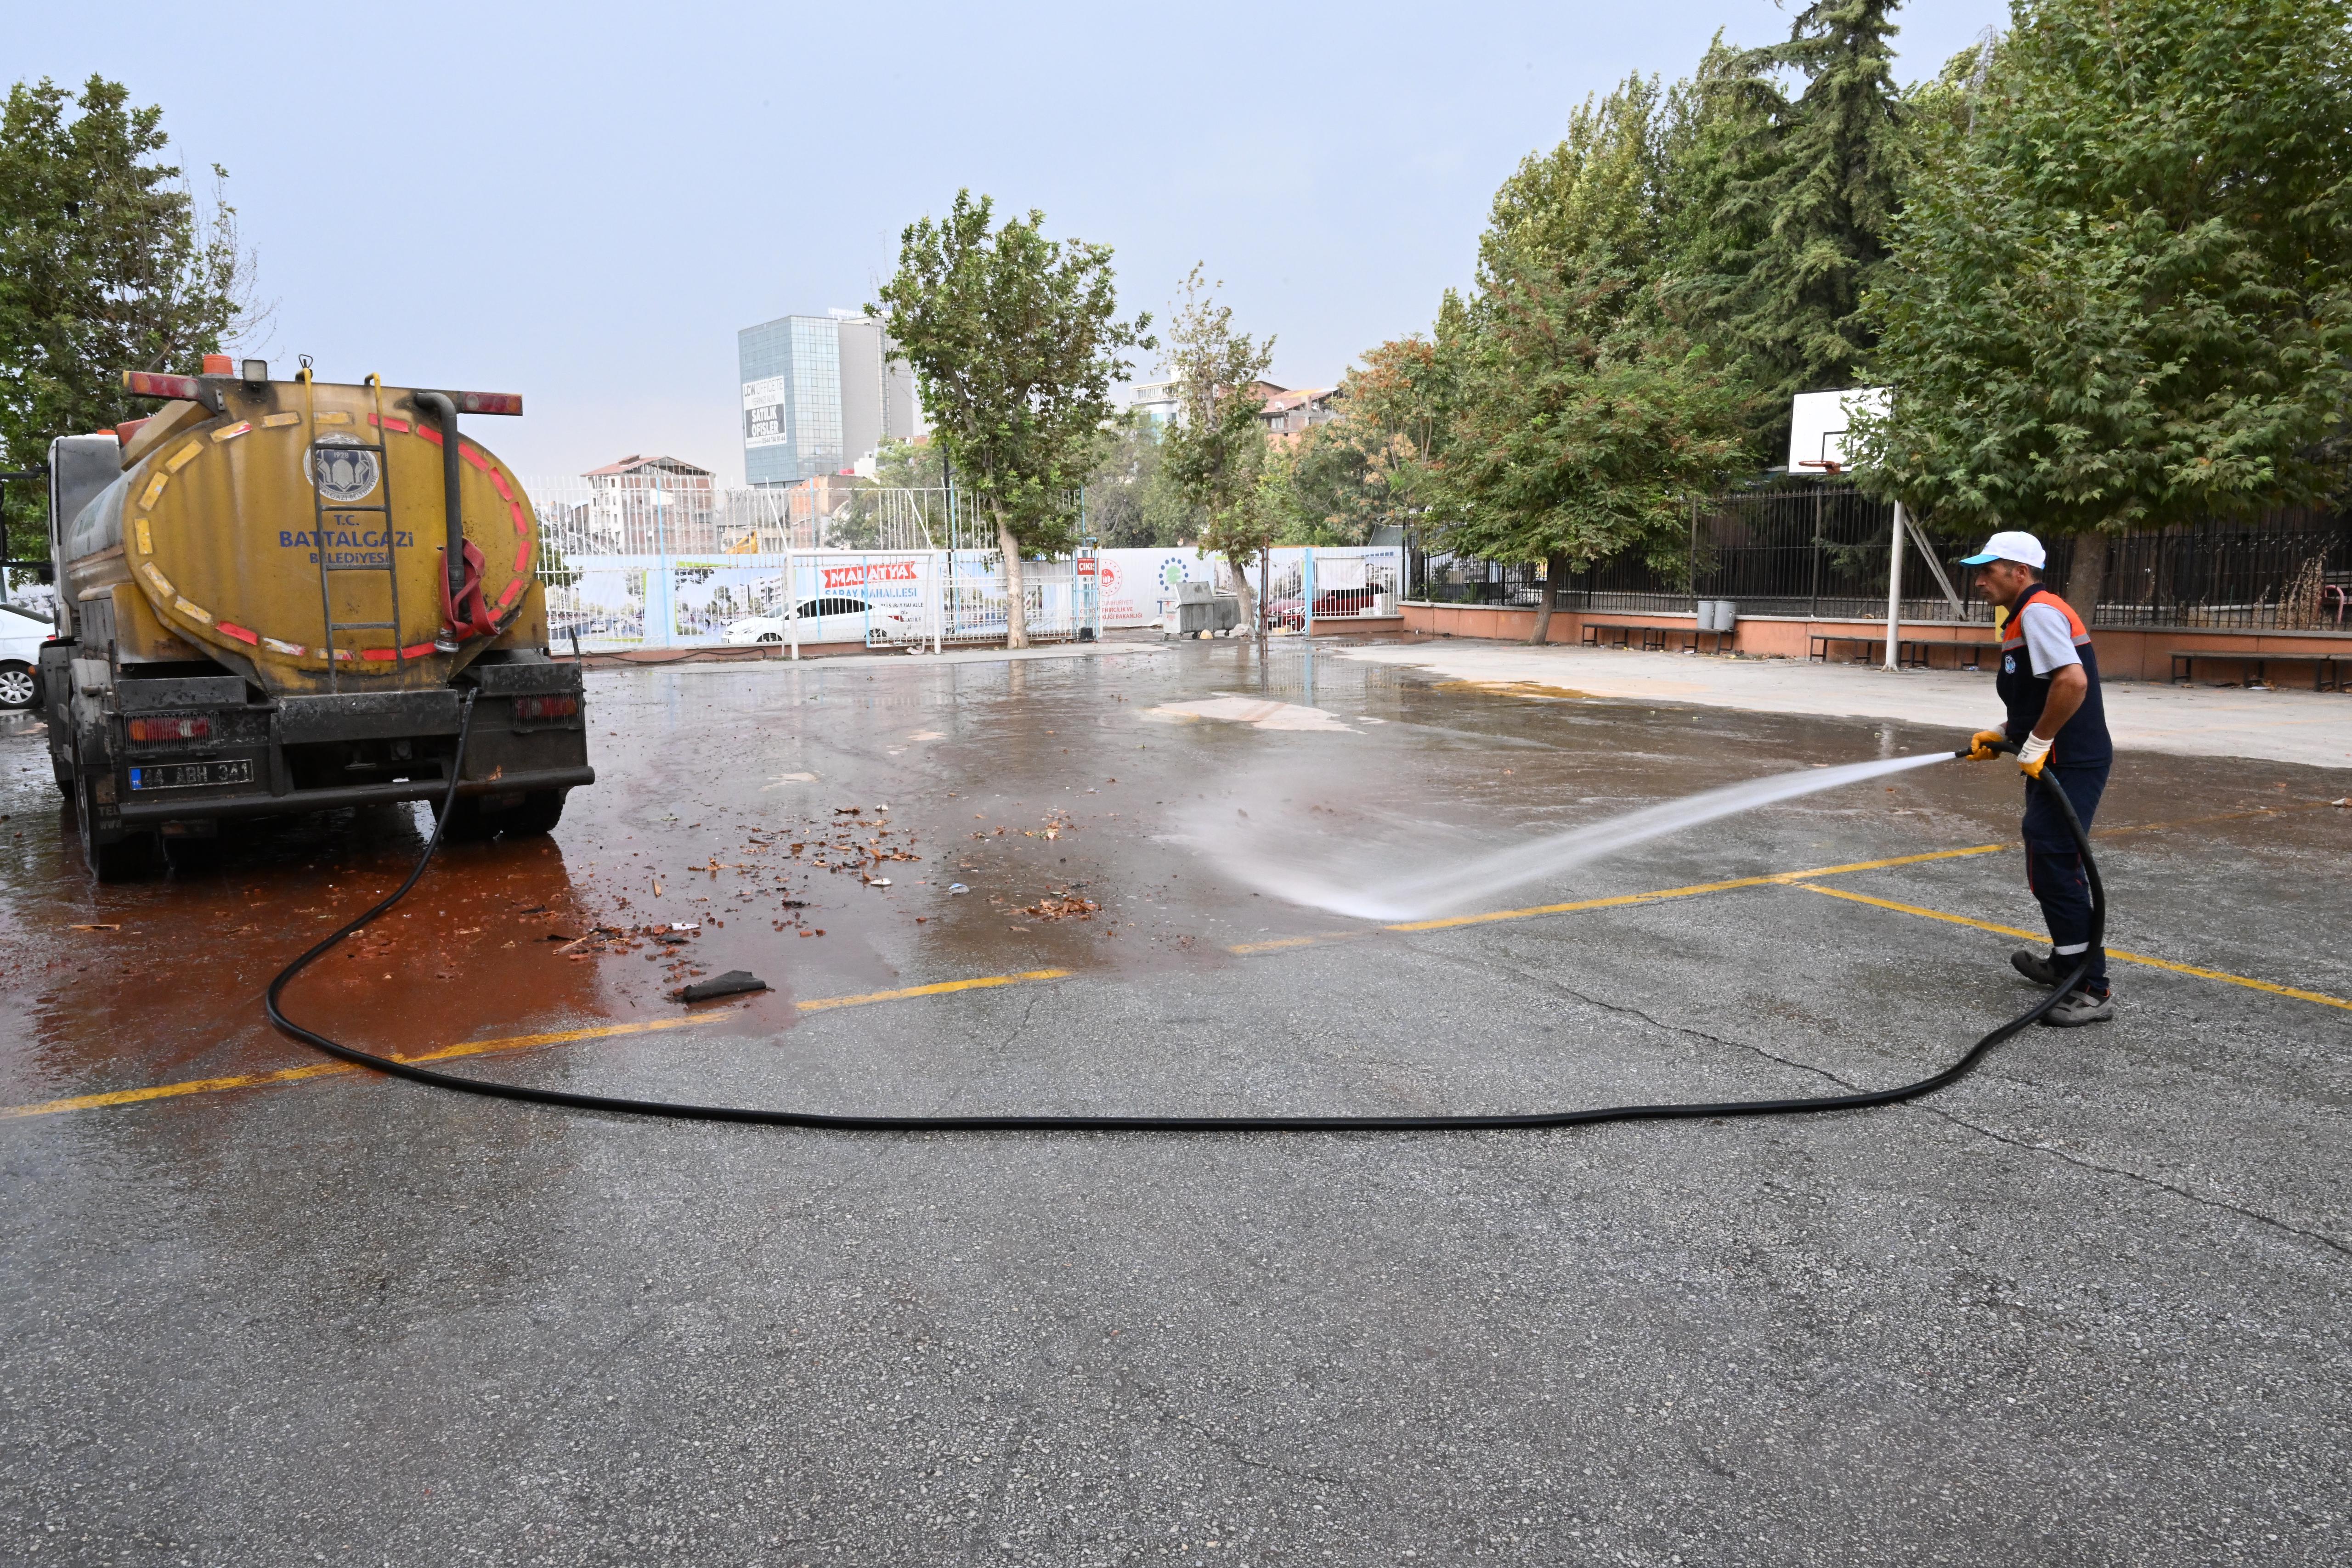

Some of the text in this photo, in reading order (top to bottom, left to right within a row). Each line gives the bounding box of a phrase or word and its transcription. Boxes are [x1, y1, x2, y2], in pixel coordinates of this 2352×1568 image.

[744, 384, 756, 397] LCW
[752, 406, 777, 423] SATILIK
[334, 514, 360, 526] T.C.
[310, 553, 390, 564] BLEDİYESİ
[832, 565, 908, 584] MALATYA
